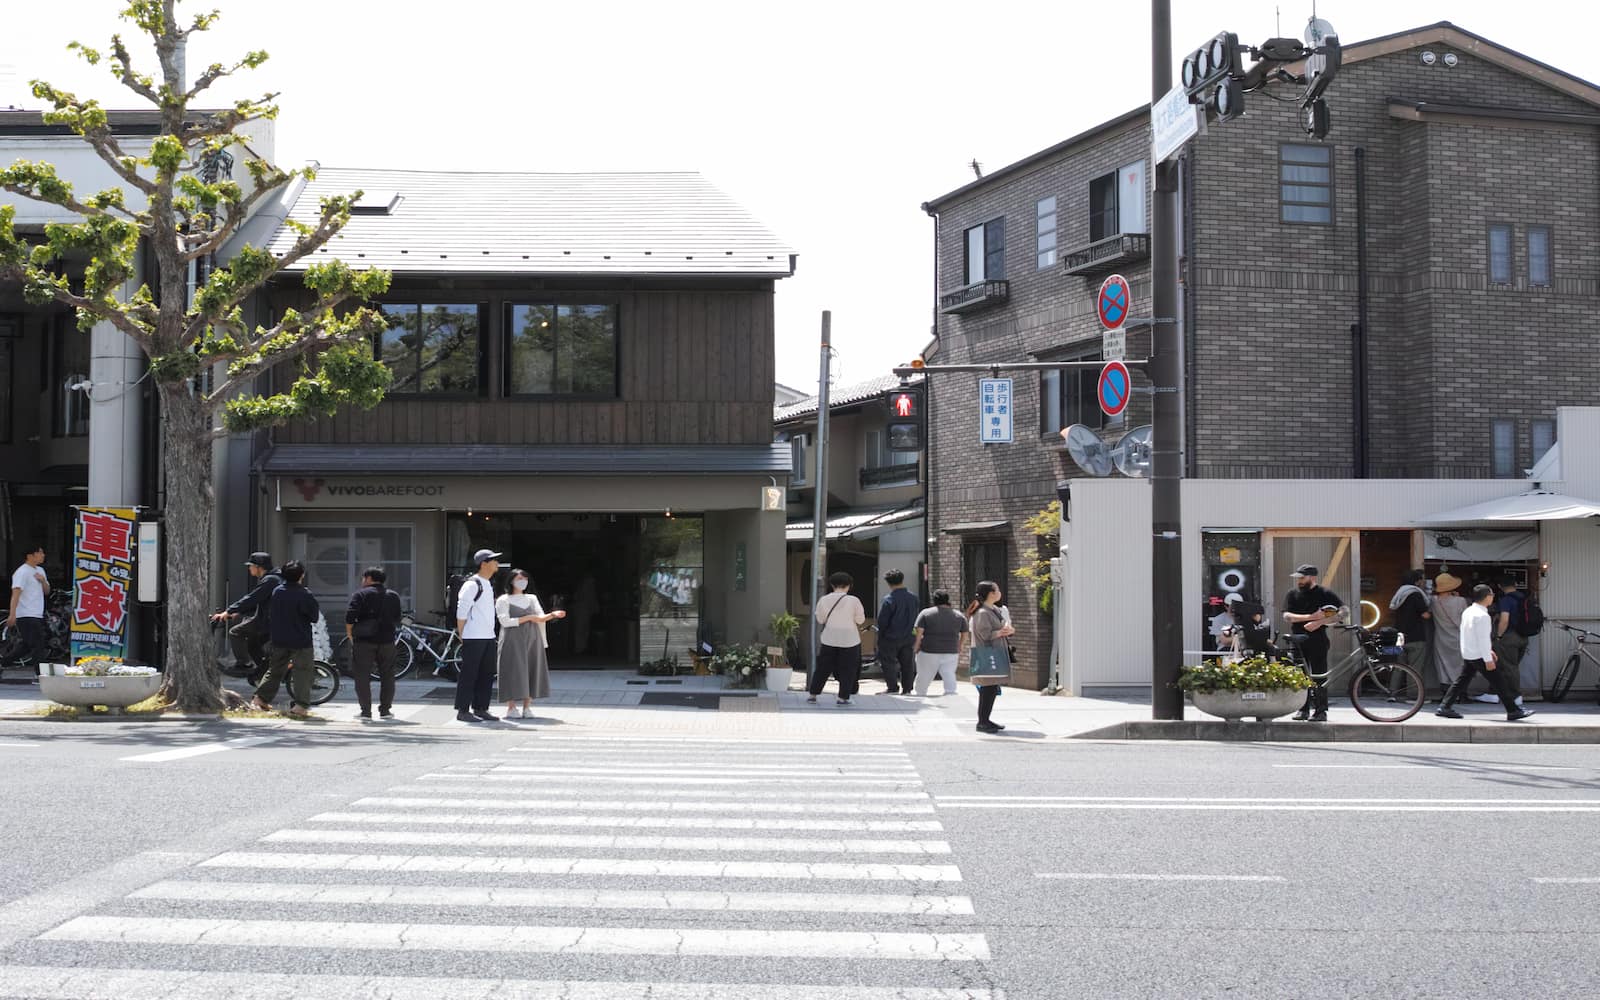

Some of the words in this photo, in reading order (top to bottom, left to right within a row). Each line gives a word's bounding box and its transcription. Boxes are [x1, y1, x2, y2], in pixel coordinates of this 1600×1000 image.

[984, 383, 994, 415] 自転車
[998, 383, 1008, 415] 歩行者
[991, 416, 1001, 438] 専用
[327, 485, 446, 497] VIVOBAREFOOT
